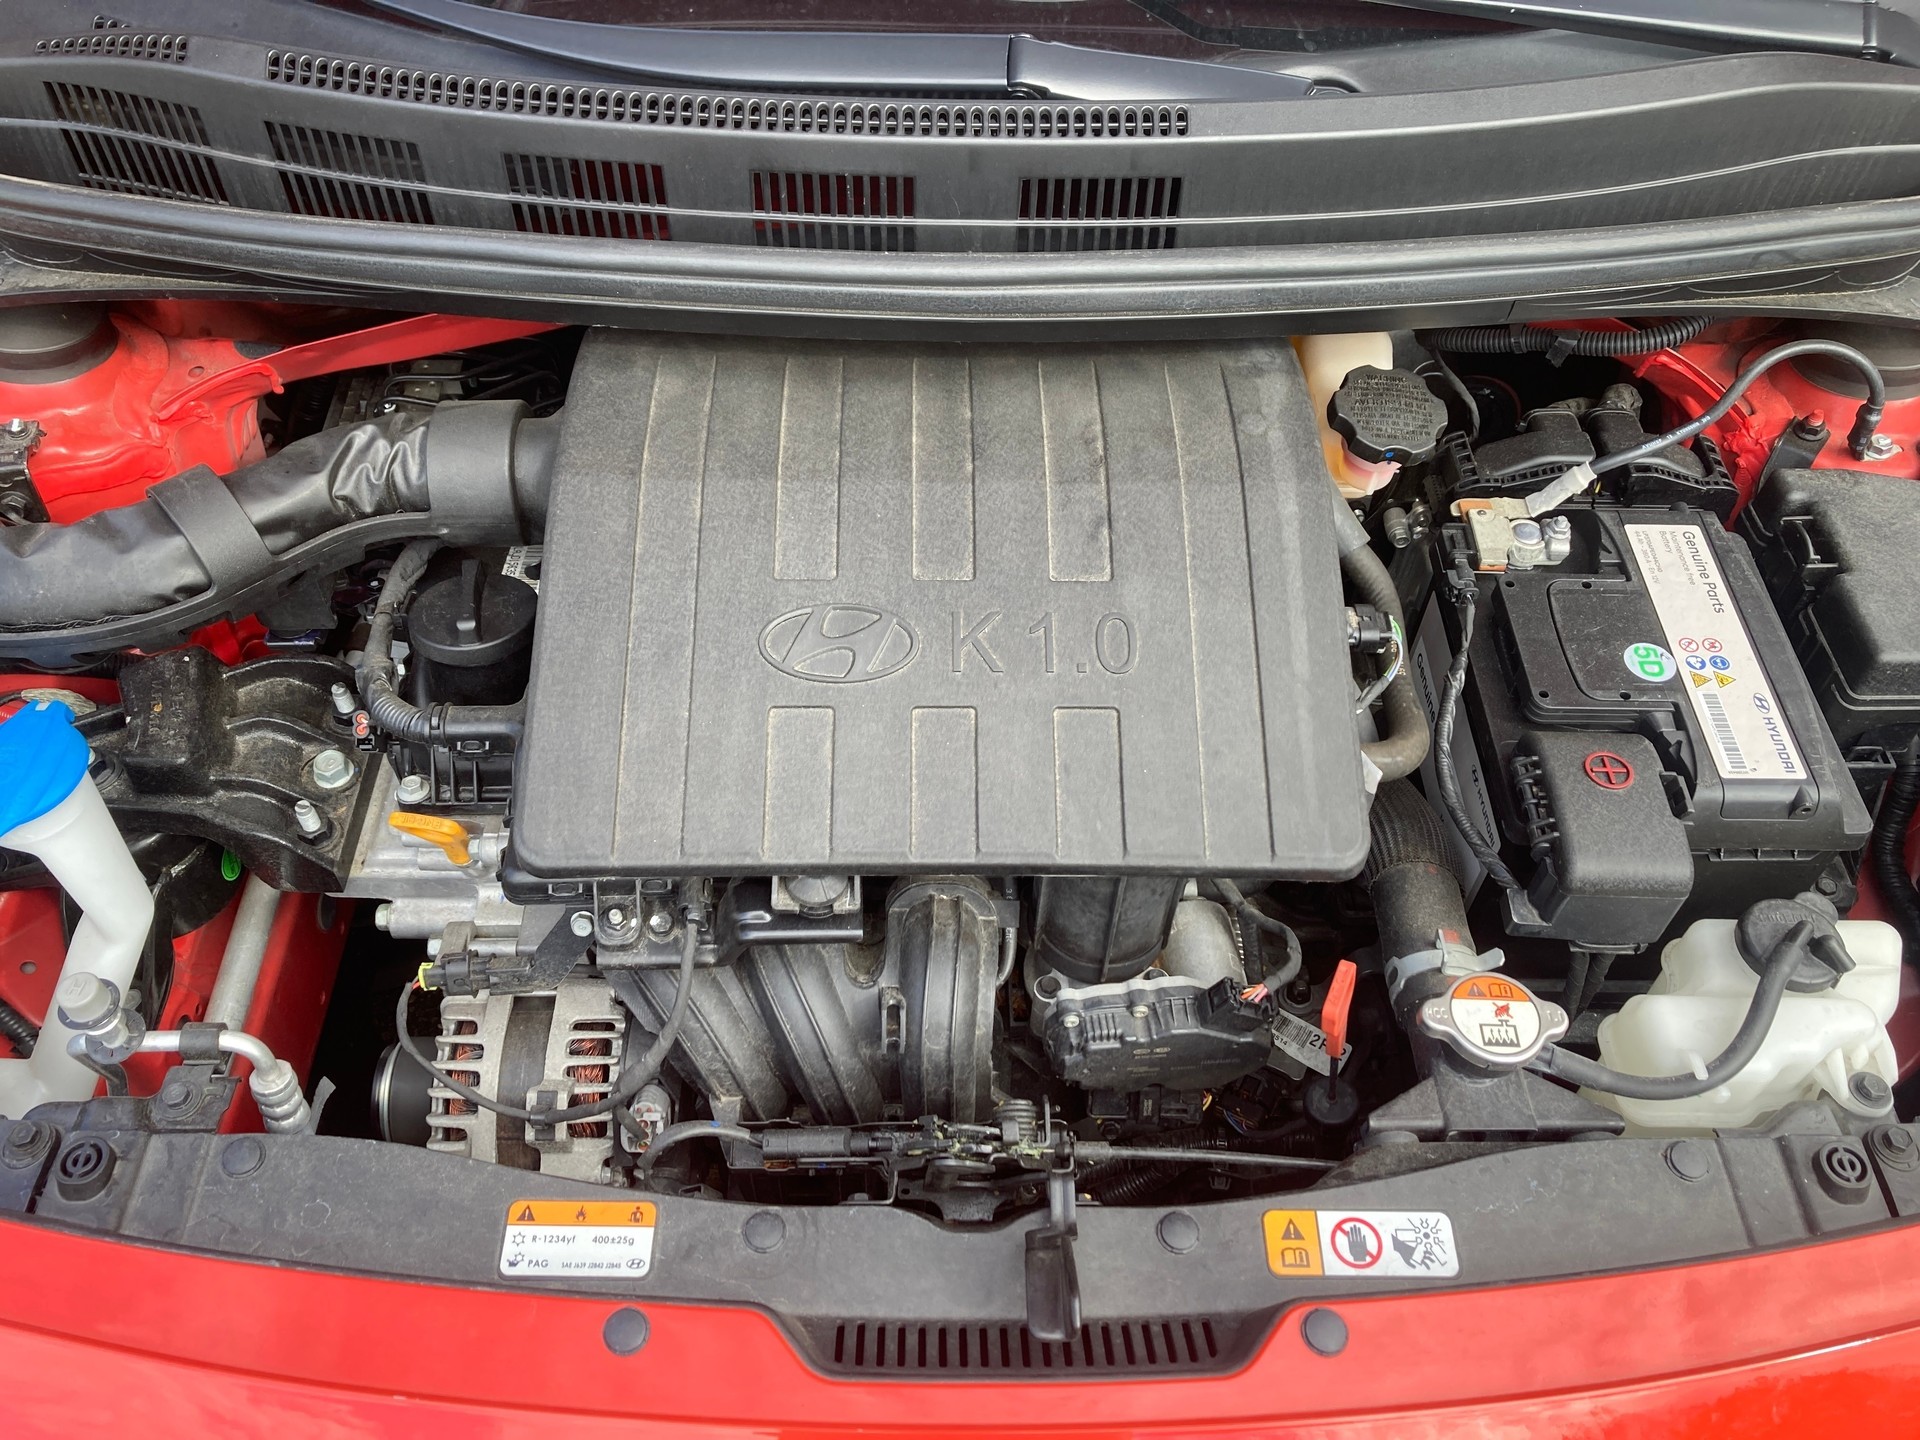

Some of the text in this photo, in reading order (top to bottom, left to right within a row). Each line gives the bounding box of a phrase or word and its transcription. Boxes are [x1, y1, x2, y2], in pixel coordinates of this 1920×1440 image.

[1659, 530, 1673, 554] Battery
[1669, 530, 1690, 573] Maintenance
[1682, 531, 1725, 614] Genuine Parts
[951, 611, 1139, 675] K 1.0
[1633, 645, 1665, 677] 5D
[1416, 652, 1436, 723] Genuine
[1762, 716, 1797, 774] HYUNDAI
[1476, 788, 1496, 848] HYUNDAI
[527, 1259, 549, 1269] PAG
[561, 1261, 572, 1269] SAE
[531, 1234, 635, 1246] R-1234yf 400±25g
